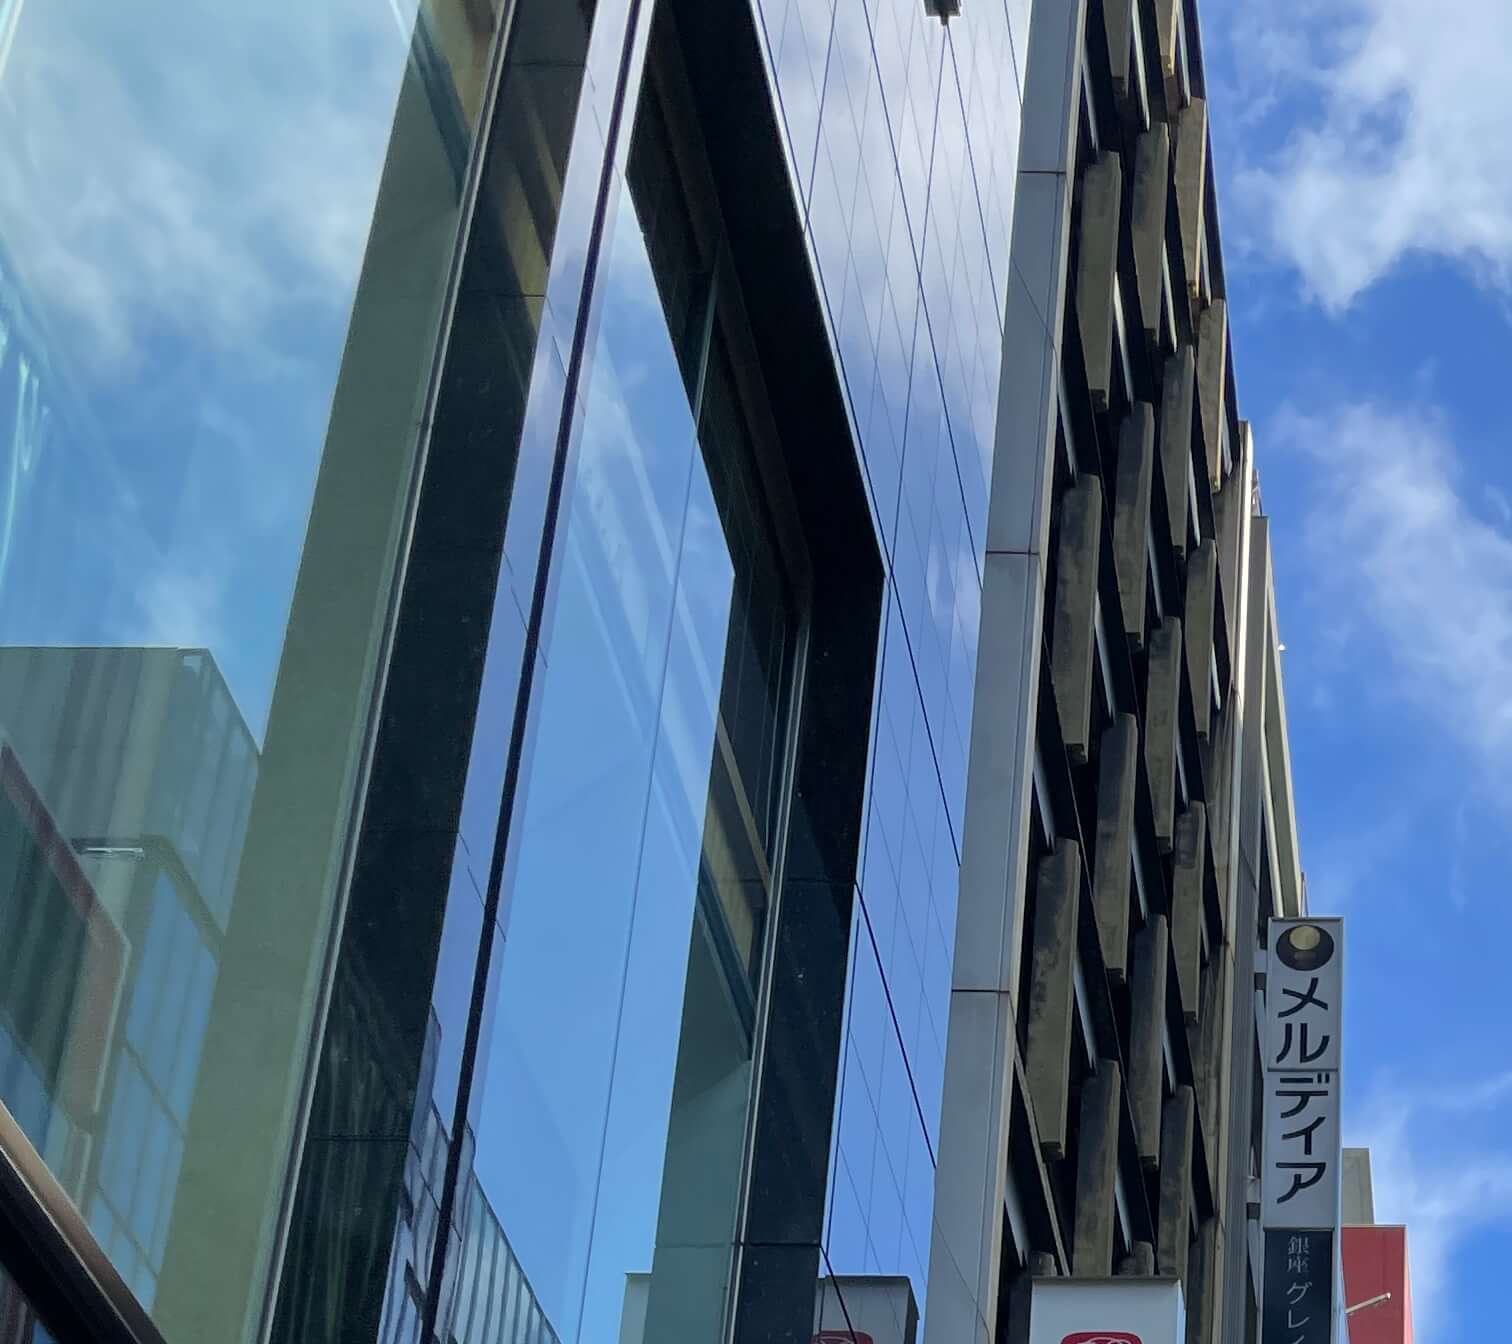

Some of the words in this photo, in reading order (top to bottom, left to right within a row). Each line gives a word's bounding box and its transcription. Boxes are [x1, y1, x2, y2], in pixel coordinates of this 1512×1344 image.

[1275, 976, 1330, 1205] メルディア
